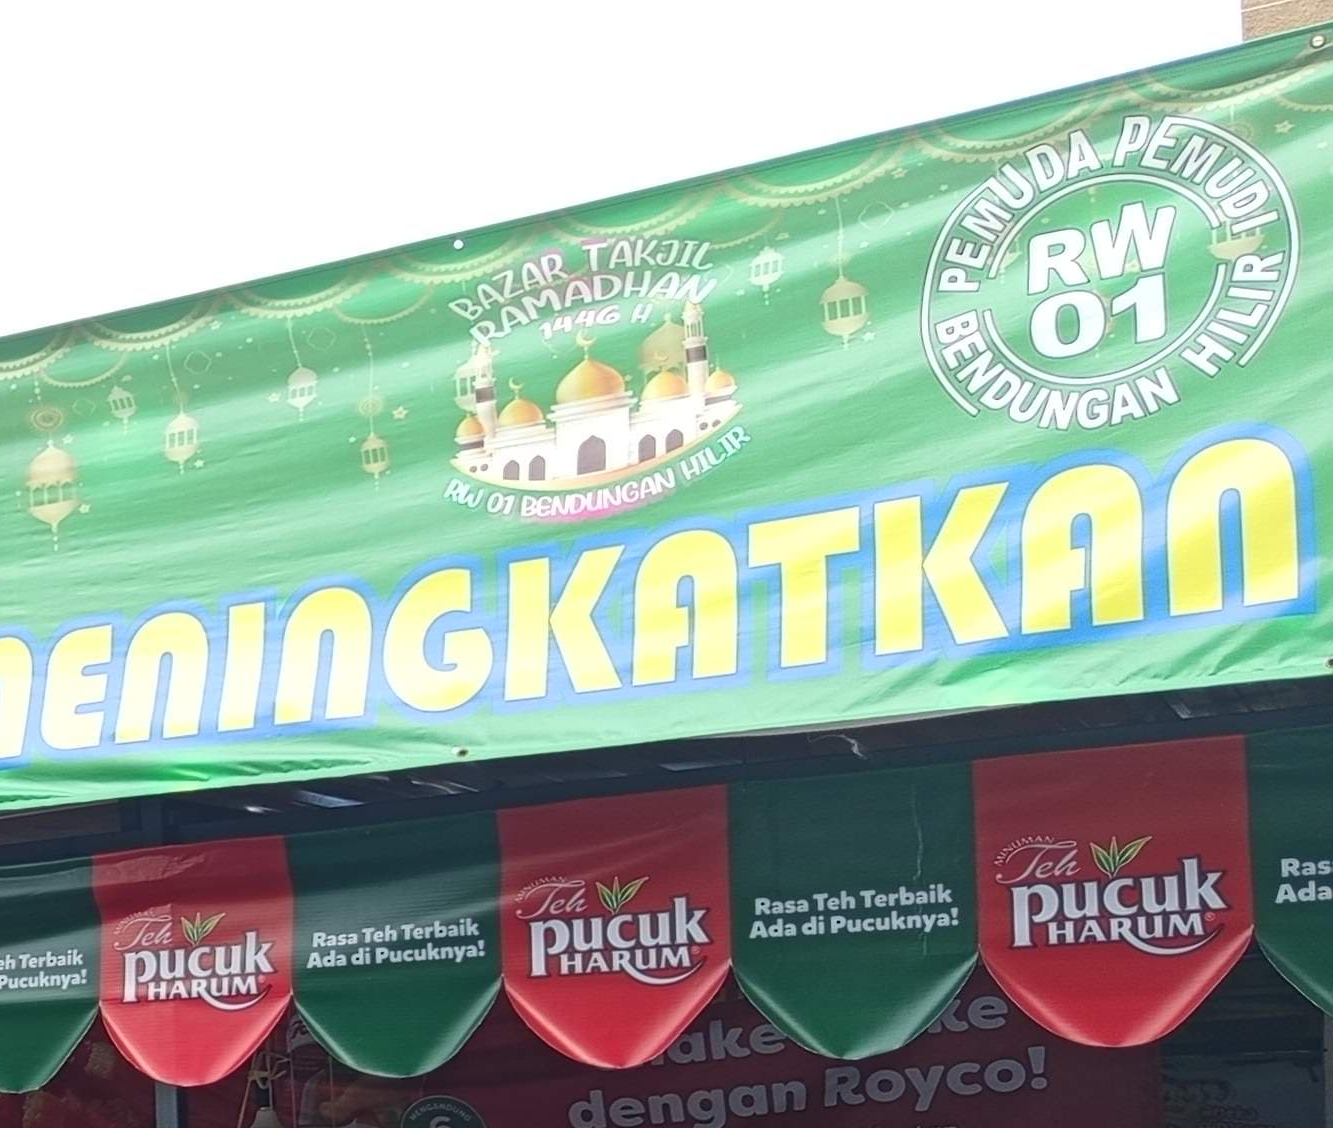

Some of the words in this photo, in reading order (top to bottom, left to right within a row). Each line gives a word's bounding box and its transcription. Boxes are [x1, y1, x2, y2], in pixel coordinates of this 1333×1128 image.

[937, 129, 1103, 292] PEMUDA
[1113, 115, 1280, 235] PEMUDI
[1027, 202, 1177, 296] RW
[448, 253, 568, 320] BAZAR
[582, 239, 714, 271] TAKJIL
[470, 272, 718, 346] RAMADHAN
[539, 305, 621, 340] 1446
[1030, 272, 1169, 358] 01
[935, 309, 1181, 431] BENDUNGAN
[1180, 250, 1286, 378] HILIR
[444, 478, 483, 509] RW
[486, 491, 514, 514] 01
[521, 467, 676, 518] BENDUNGAN
[682, 425, 751, 481] HILIR
[995, 839, 1081, 884] Teh
[1280, 857, 1333, 878] Ras
[515, 879, 589, 919] Teh
[754, 895, 809, 915] Rasa
[812, 890, 856, 912] Teh
[859, 884, 953, 909] Terbaik
[1011, 858, 1228, 948] pucuk
[114, 914, 174, 951] Teh
[312, 927, 361, 948] Rasa
[362, 925, 399, 944] Teh
[401, 917, 480, 940] Terbaik
[529, 897, 712, 978] pucuk
[749, 919, 798, 940] Ada
[801, 915, 827, 936] di
[830, 908, 960, 934] Pucuknya!
[1047, 911, 1208, 951] HARUM
[18, 949, 84, 969] Terbaik
[122, 931, 275, 1004] pucuk
[306, 948, 348, 969] Ada
[351, 946, 372, 966] di
[375, 939, 485, 964] Pucuknya!
[560, 948, 695, 979] HARUM
[147, 975, 261, 1003] HARUM
[823, 1044, 1049, 1113] Royco!
